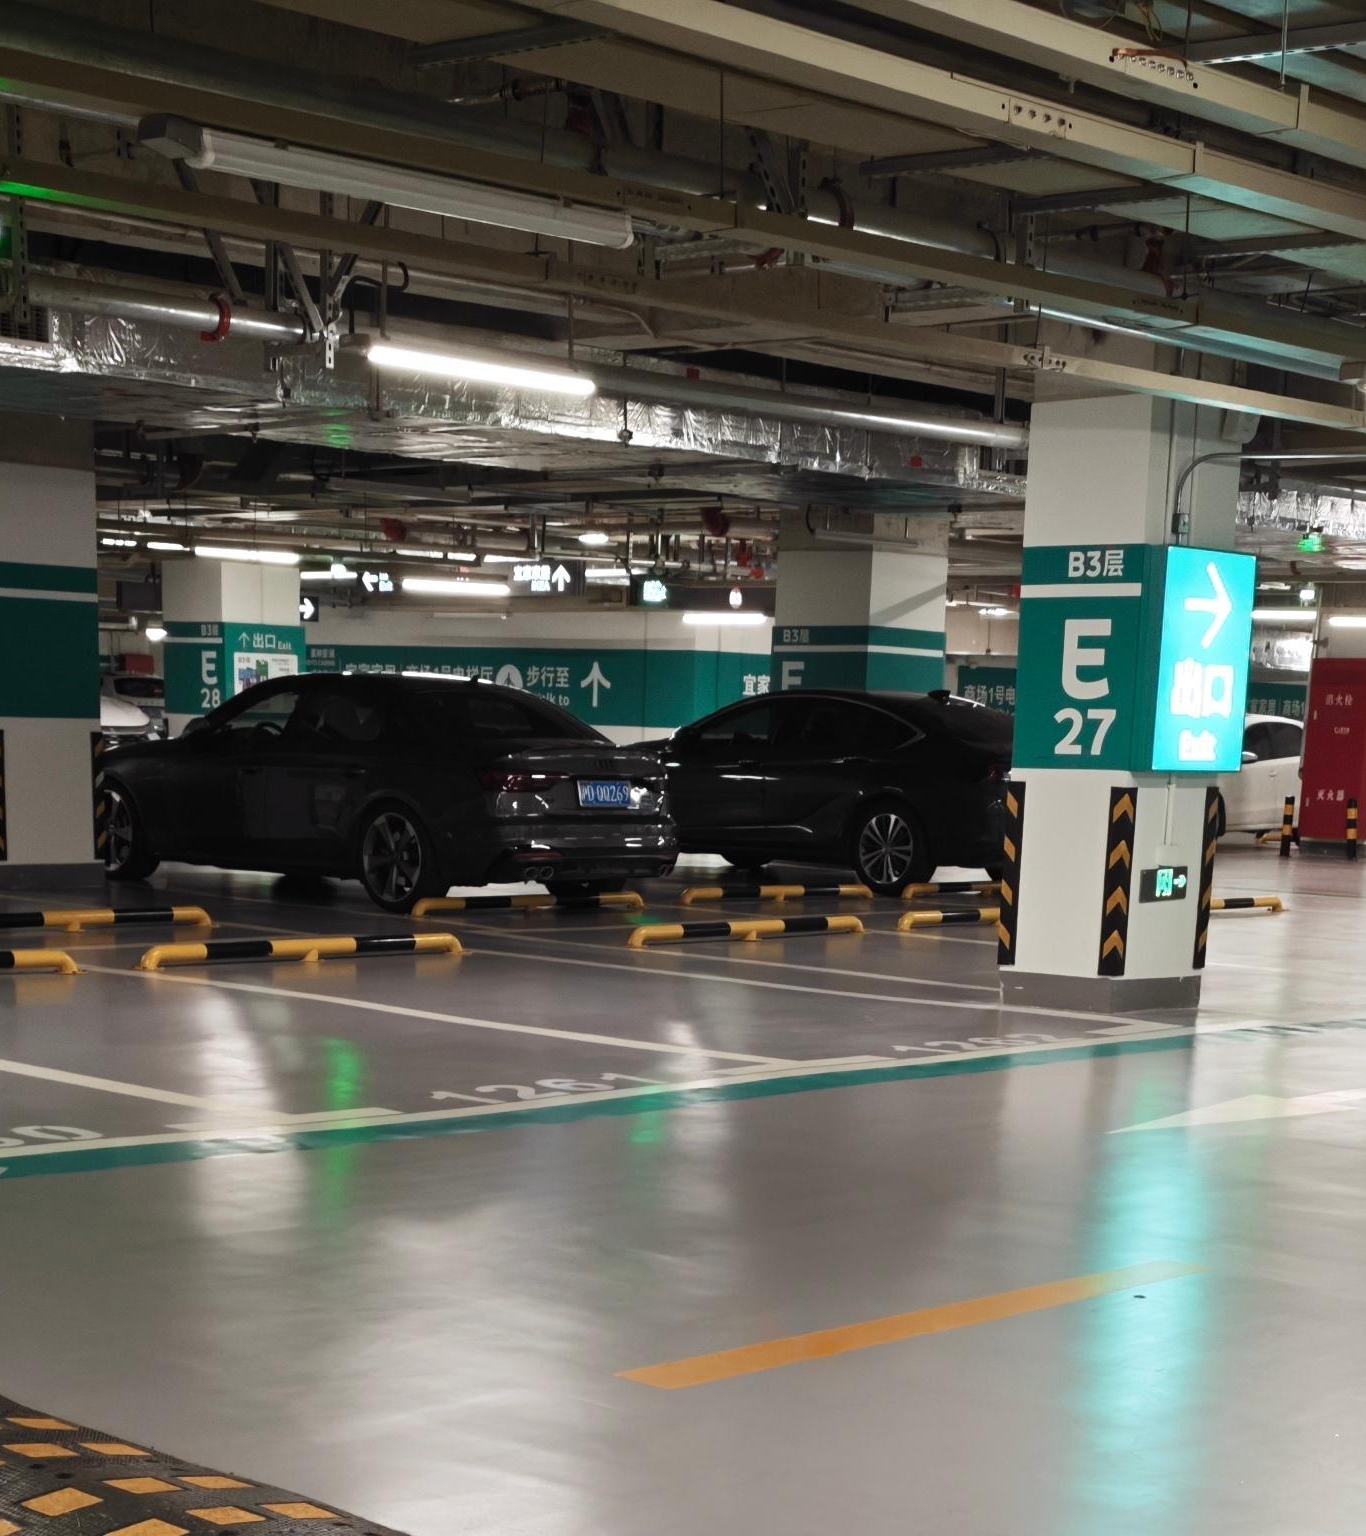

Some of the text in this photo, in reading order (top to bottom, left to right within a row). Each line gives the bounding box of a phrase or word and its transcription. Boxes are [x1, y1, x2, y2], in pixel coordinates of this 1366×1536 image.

[1067, 549, 1124, 578] B3层
[252, 632, 276, 649] 出口
[201, 650, 219, 685] E
[1061, 618, 1112, 700] E
[526, 666, 570, 688] 步行至
[742, 673, 771, 697] 宜家
[200, 687, 222, 709] 28
[1053, 707, 1117, 756] 27
[431, 1072, 668, 1104] 1261
